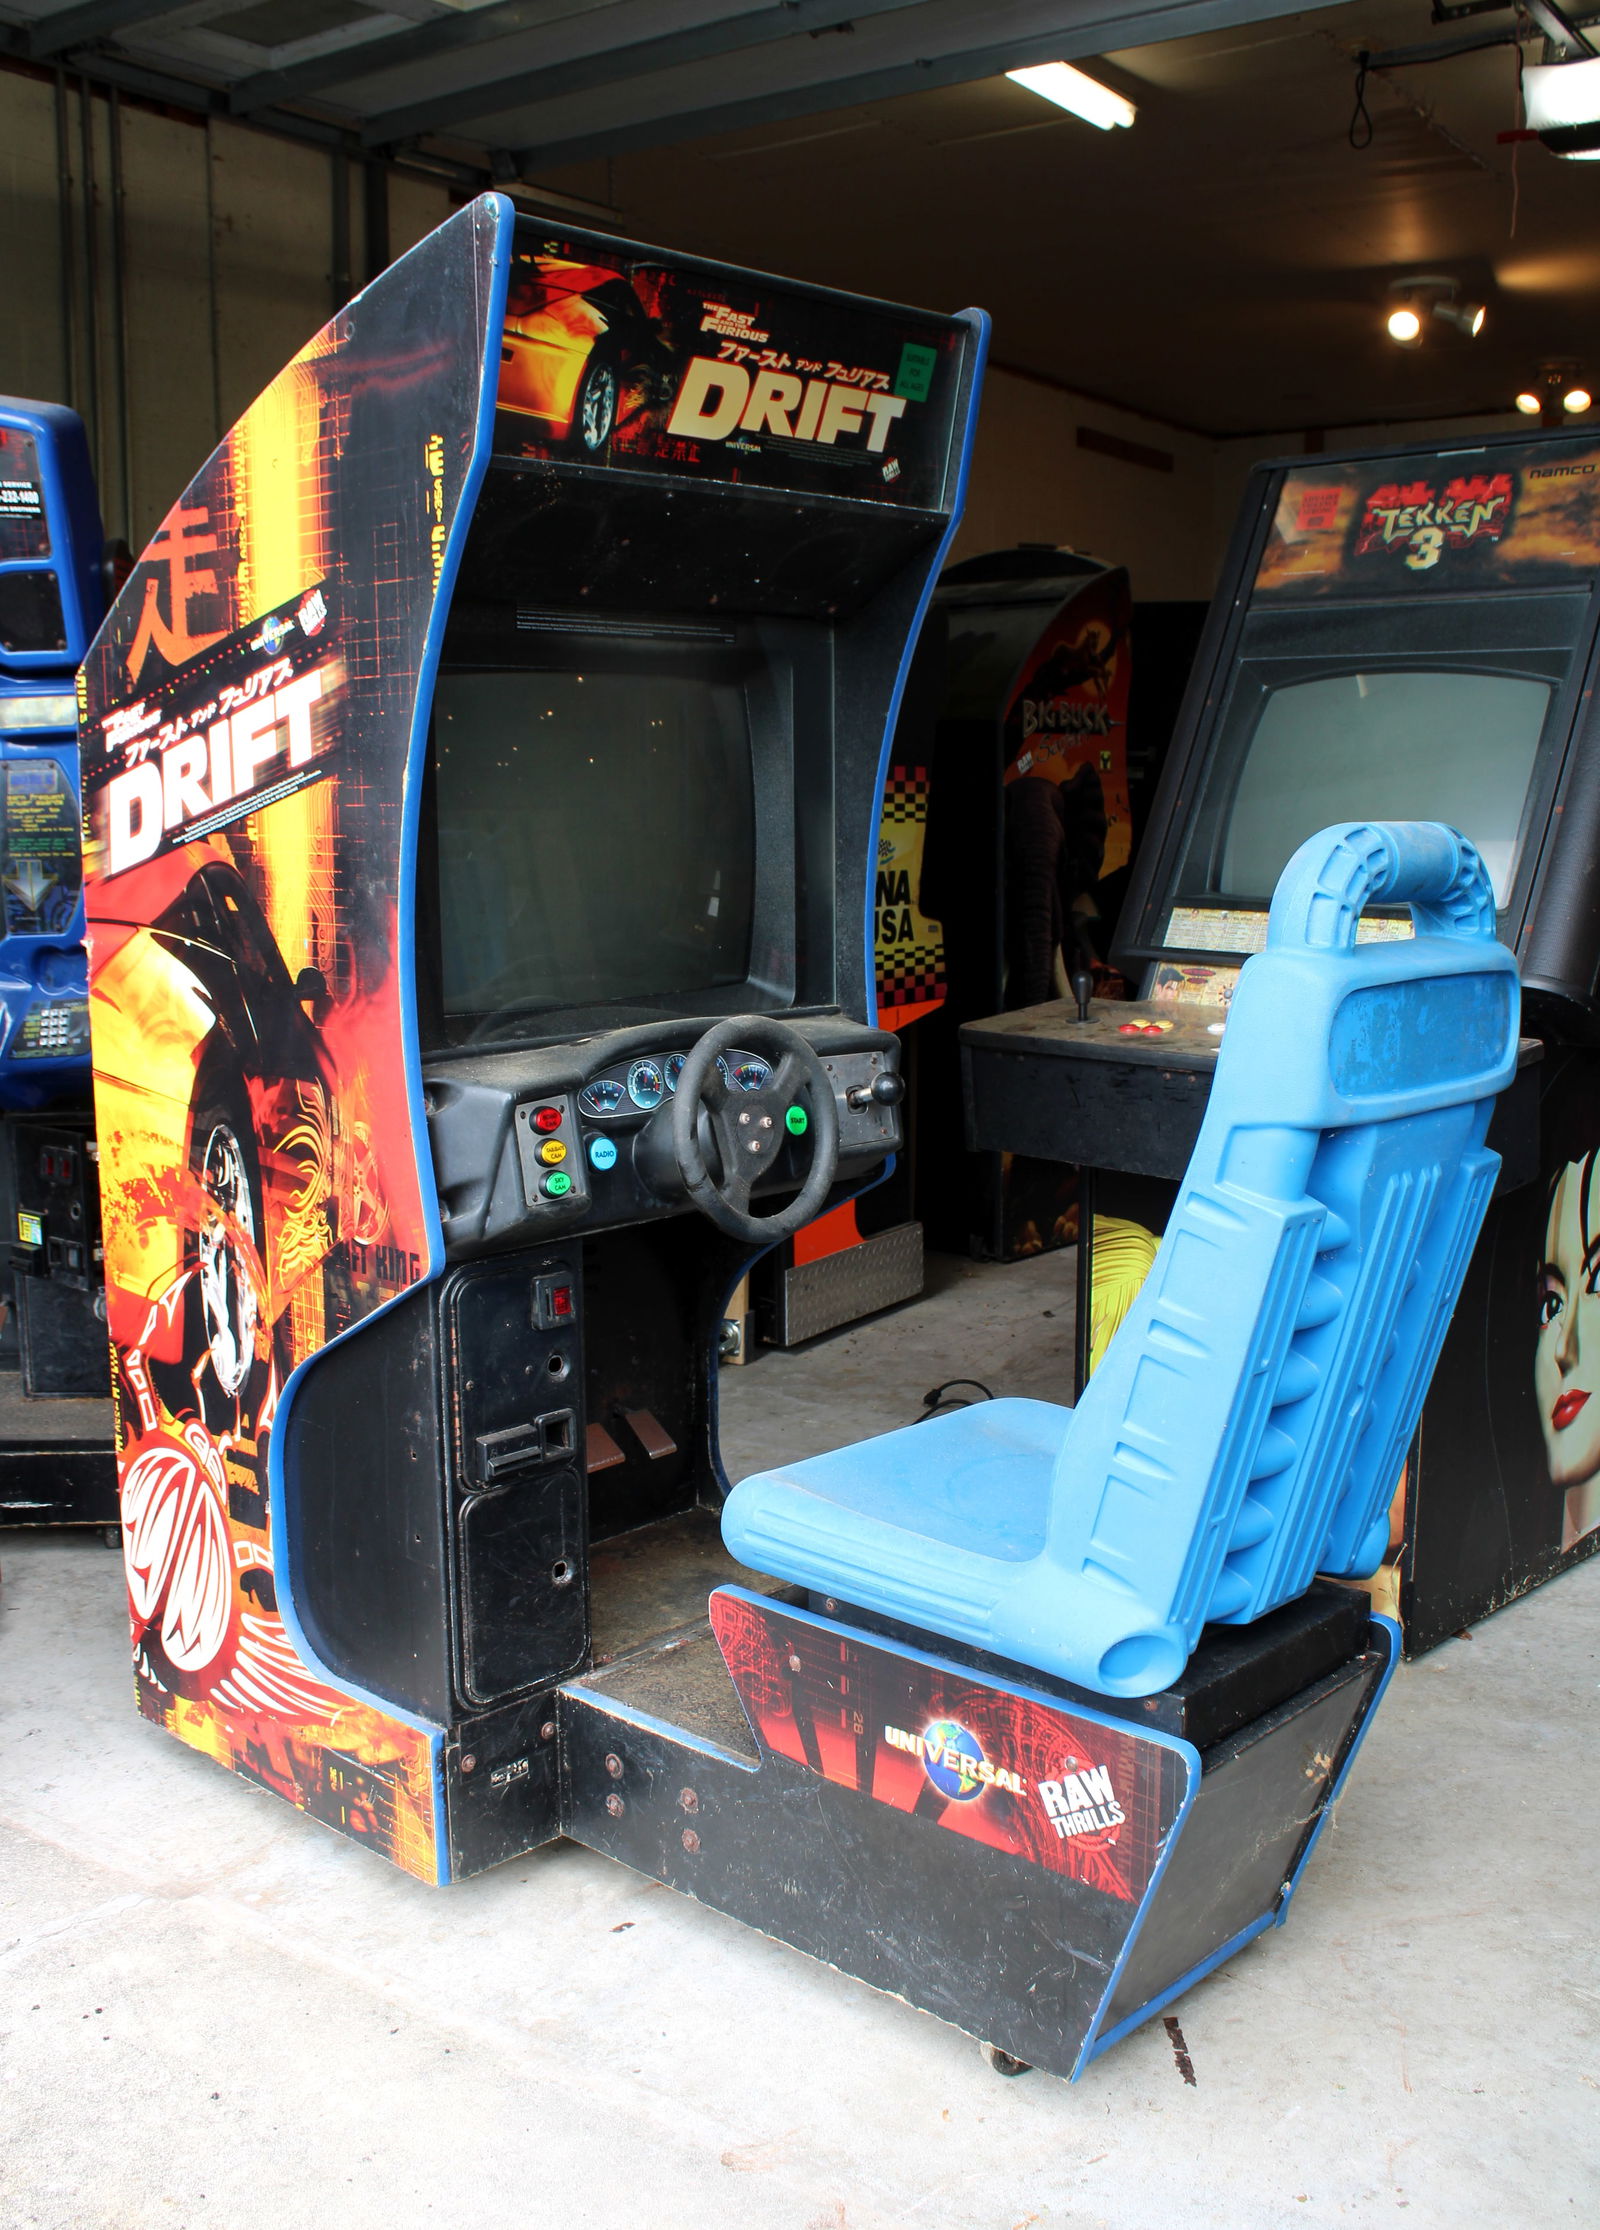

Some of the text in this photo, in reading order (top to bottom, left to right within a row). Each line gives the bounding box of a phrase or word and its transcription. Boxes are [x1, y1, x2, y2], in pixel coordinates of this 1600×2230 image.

[700, 315, 769, 343] FURIOUS
[715, 306, 755, 326] FAST
[667, 356, 907, 454] DRIFT
[725, 440, 762, 453] UNIVERSAL
[882, 458, 901, 477] RAW
[1529, 464, 1597, 480] namco
[1372, 496, 1506, 545] TEKKEN
[1403, 525, 1445, 570] 3
[1023, 699, 1109, 738] BIG BUCK
[109, 668, 322, 876] DRIFT
[595, 1150, 614, 1158] RADIO
[884, 1724, 1028, 1797] UNIVERSAL
[1037, 1764, 1116, 1818] RAW
[1050, 1799, 1127, 1840] THRILLS
